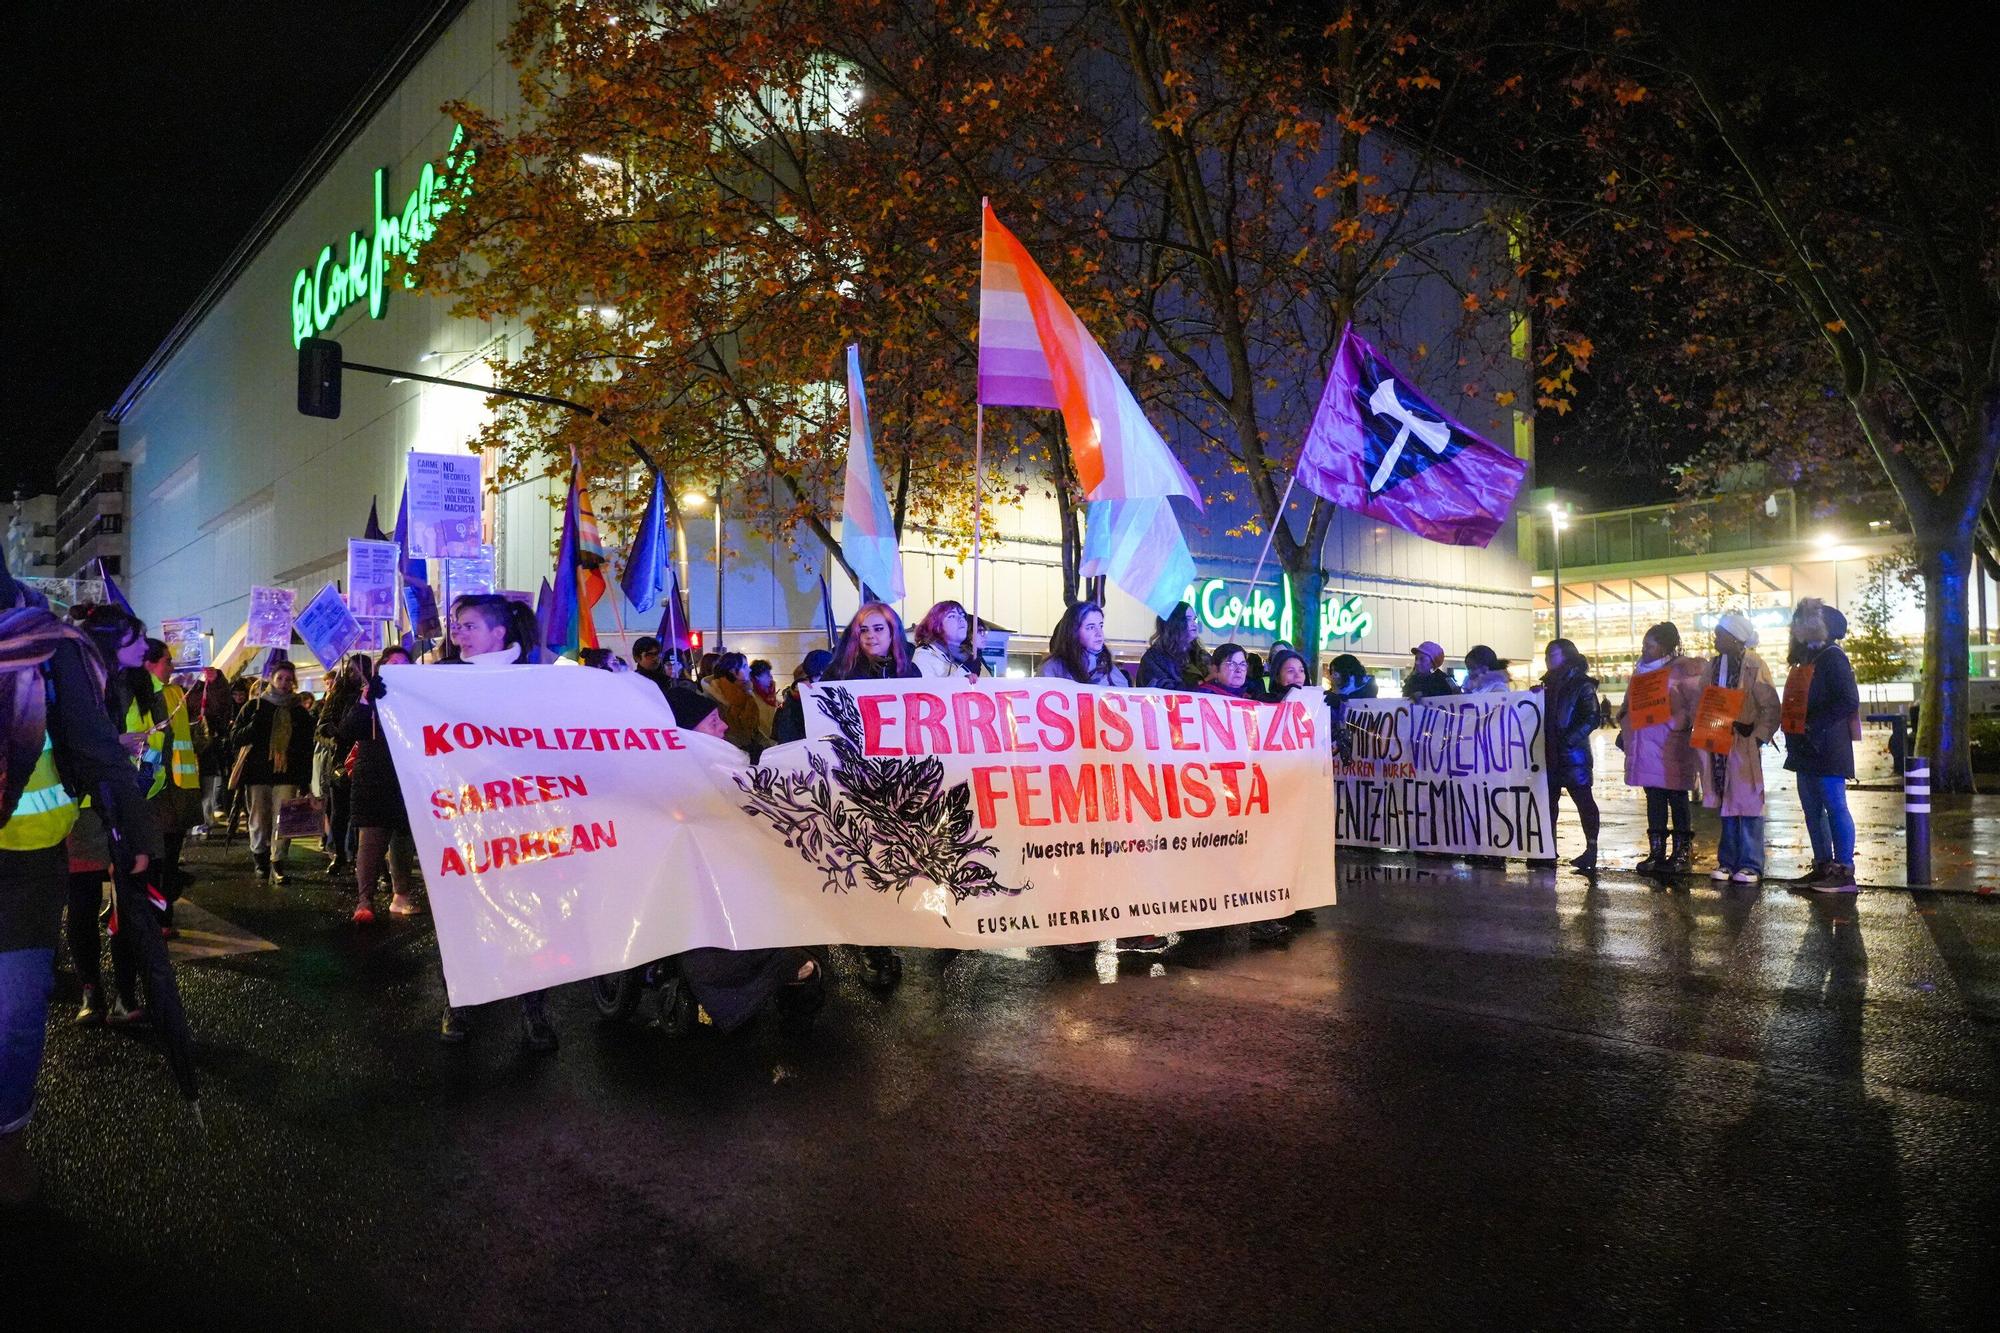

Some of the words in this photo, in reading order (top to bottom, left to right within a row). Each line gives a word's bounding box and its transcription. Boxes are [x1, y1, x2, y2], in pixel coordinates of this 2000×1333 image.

[314, 231, 368, 331] Corte
[443, 461, 454, 472] NO
[444, 503, 475, 513] MACHISTA
[1202, 579, 1277, 631] Corte
[422, 722, 687, 756] KONPLIZITATE
[857, 690, 1316, 756] ERRESISTENTZIA
[430, 775, 589, 820] SAREEN
[971, 761, 1270, 829] FEMINISTA
[440, 820, 618, 876] AURREAN
[1022, 841, 1086, 865] ¡Vuestra
[1091, 834, 1168, 857] hipocresía
[1172, 836, 1187, 851] es
[977, 914, 1040, 934] EUSKAL
[1048, 906, 1120, 927] HERRIKO
[1128, 896, 1218, 918] MUGIMENDU
[1224, 887, 1291, 909] FEMINISTA
